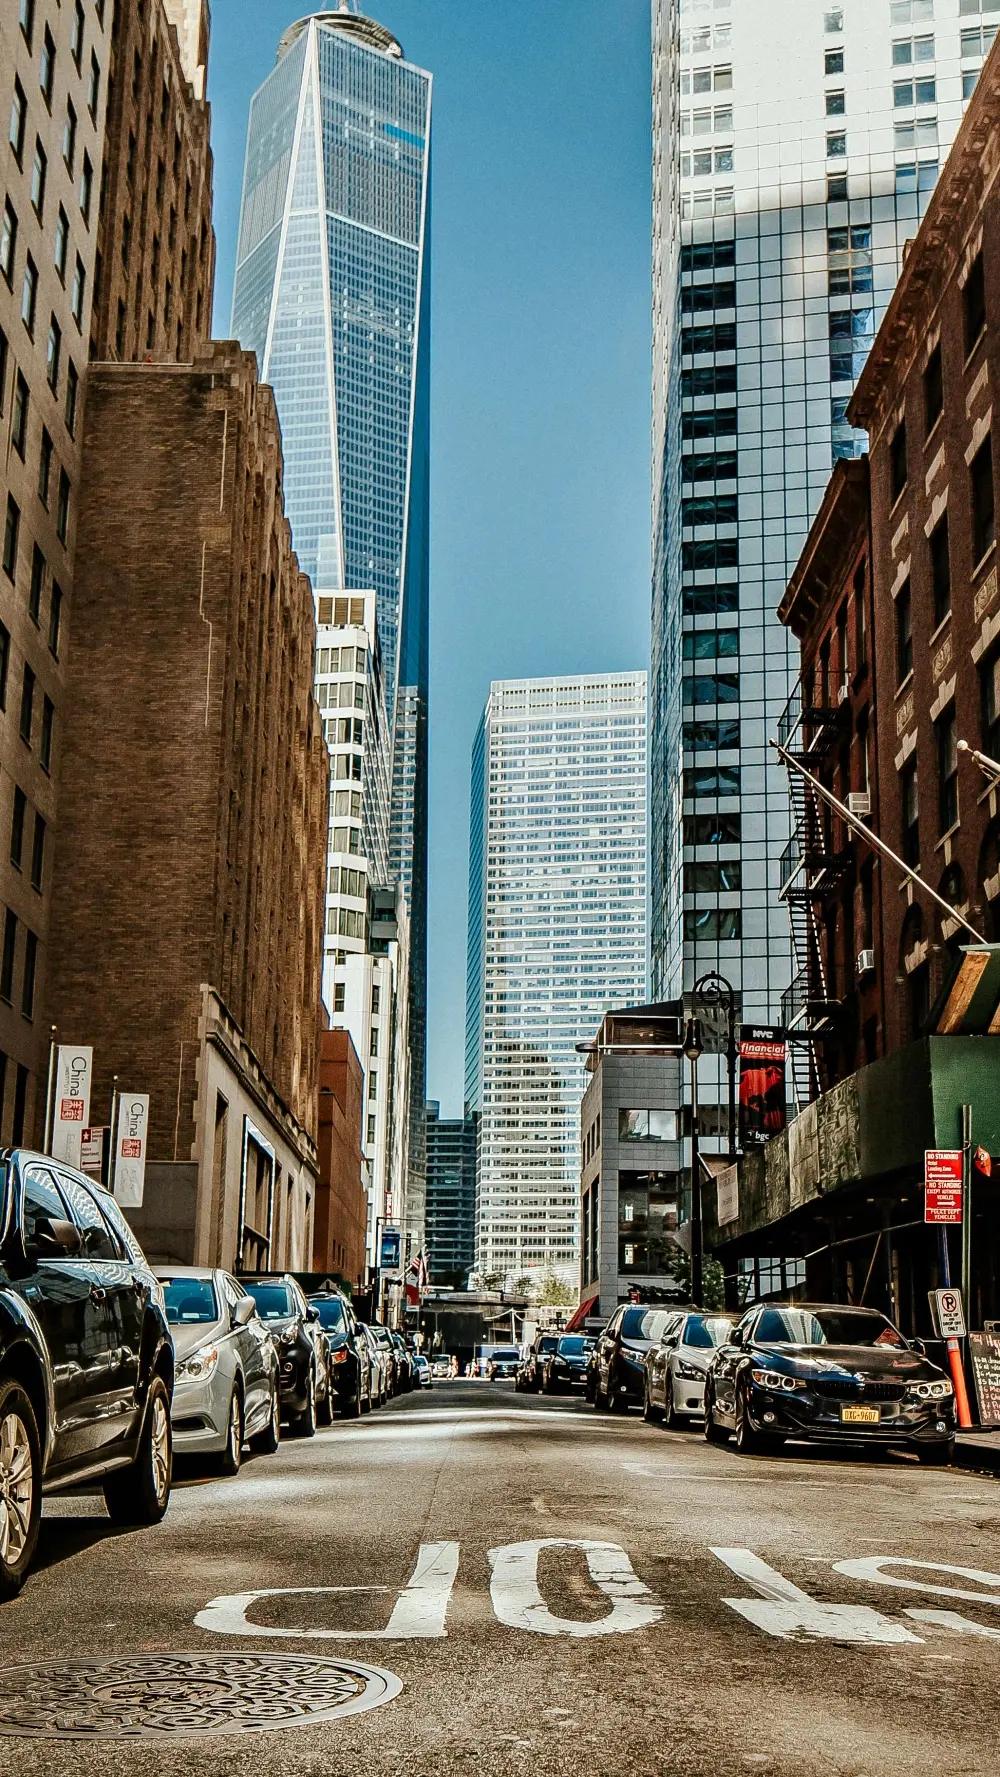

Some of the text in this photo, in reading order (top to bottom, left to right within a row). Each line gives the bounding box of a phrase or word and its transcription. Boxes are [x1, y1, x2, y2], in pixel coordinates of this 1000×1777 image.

[753, 1030, 773, 1038] NYC
[741, 1043, 784, 1053] financial
[70, 1056, 86, 1096] China
[130, 1103, 144, 1136] China
[755, 1131, 770, 1141] bgc
[194, 1539, 1000, 1644] STOP
